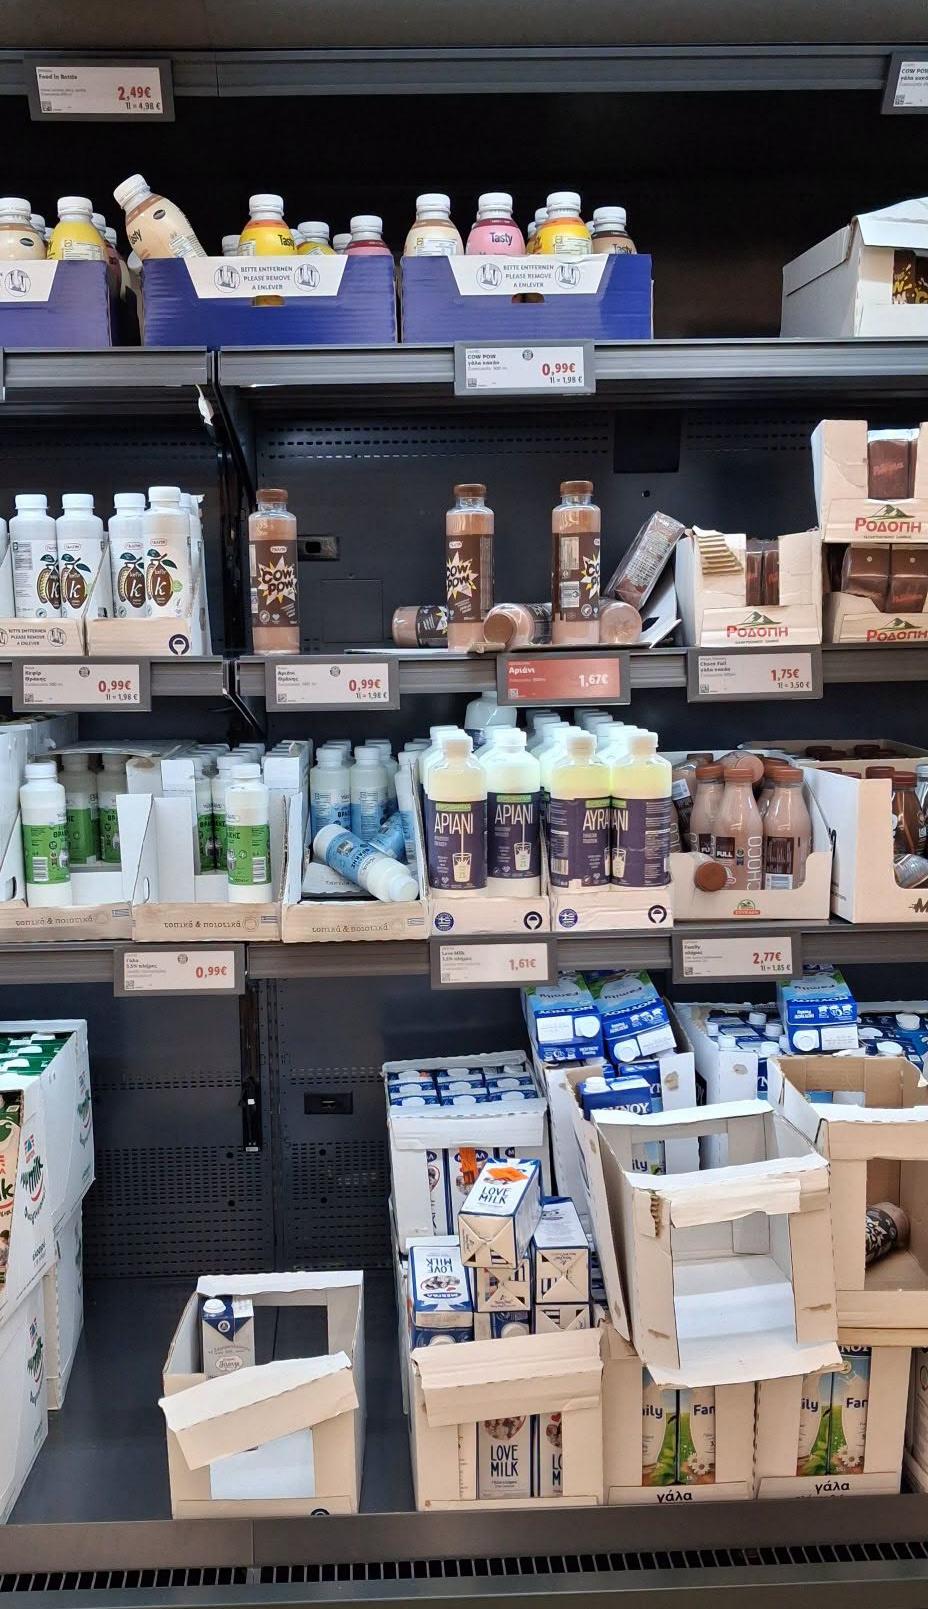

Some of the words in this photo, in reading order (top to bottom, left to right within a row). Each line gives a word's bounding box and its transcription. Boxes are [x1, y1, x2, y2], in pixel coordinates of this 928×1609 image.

[117, 86, 152, 100] 2,49€
[490, 232, 513, 246] Tasty
[542, 363, 576, 376] 0,99€
[261, 569, 292, 584] COW
[268, 580, 294, 596] POW
[508, 667, 536, 675] Αριάνι
[770, 669, 800, 681] 1,75€
[98, 680, 132, 693] 0,99€
[348, 679, 381, 692] 0,99€
[578, 674, 608, 688] 1,67€
[582, 809, 610, 831] AYRA
[510, 959, 536, 970] 1,61€
[752, 952, 782, 964] 2,77€
[196, 966, 227, 978] 0,99€
[632, 1158, 648, 1172] ily
[482, 1186, 512, 1196] LOVE
[478, 1194, 506, 1204] MILK
[801, 1398, 818, 1412] ily
[490, 1444, 518, 1461] LOVE
[490, 1462, 518, 1476] MILK
[815, 1480, 850, 1494] γάλα
[656, 1490, 692, 1504] γάλα
